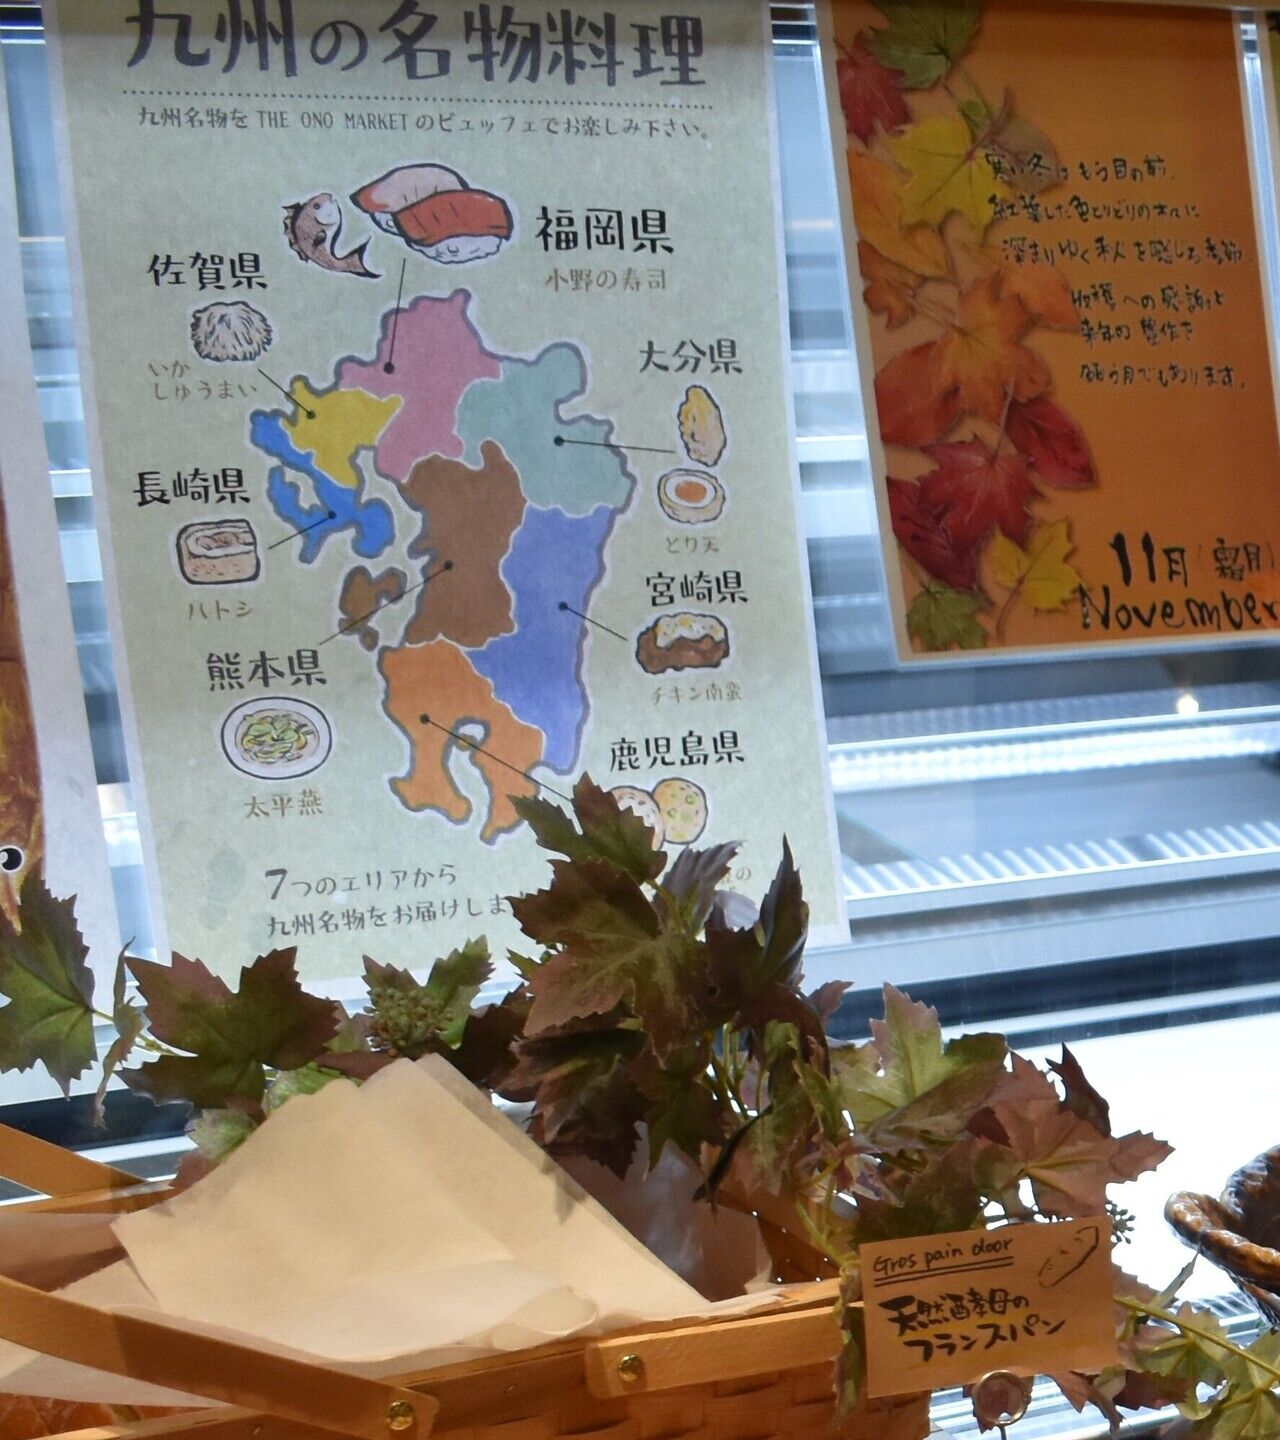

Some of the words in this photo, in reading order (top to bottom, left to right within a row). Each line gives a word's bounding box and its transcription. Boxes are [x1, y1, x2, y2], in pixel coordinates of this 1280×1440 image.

[125, 0, 707, 86] 九州の名物料理
[138, 106, 249, 129] 九州名物を
[256, 110, 290, 129] THE
[300, 110, 334, 130] ONO
[344, 112, 409, 131] MARKET
[415, 112, 709, 141] のビュッフェでお楽しみ下さい。
[535, 205, 676, 257] 福岡県
[147, 252, 269, 292] 佐賀県
[544, 266, 667, 293] 小野の寿司
[147, 360, 192, 379] いか
[638, 338, 743, 377] 大分県
[152, 379, 259, 401] しゅうまい
[134, 469, 252, 506] 長崎県
[664, 534, 721, 555] とり天
[645, 570, 750, 607] 宮崎県
[1075, 583, 1280, 631] November
[186, 599, 255, 622] ハトシ
[205, 647, 330, 692] 熊本県
[650, 681, 743, 706] チキン南蛮
[609, 730, 746, 772] 鹿児島県
[244, 789, 325, 820] 太平燕
[264, 863, 459, 899] 7つのエリアから
[266, 891, 524, 938] 九州名物をお届けしま
[873, 1252, 917, 1278] Gros
[924, 1242, 964, 1270] pain
[972, 1237, 1013, 1257] door
[903, 1313, 1067, 1363] フランスパン
